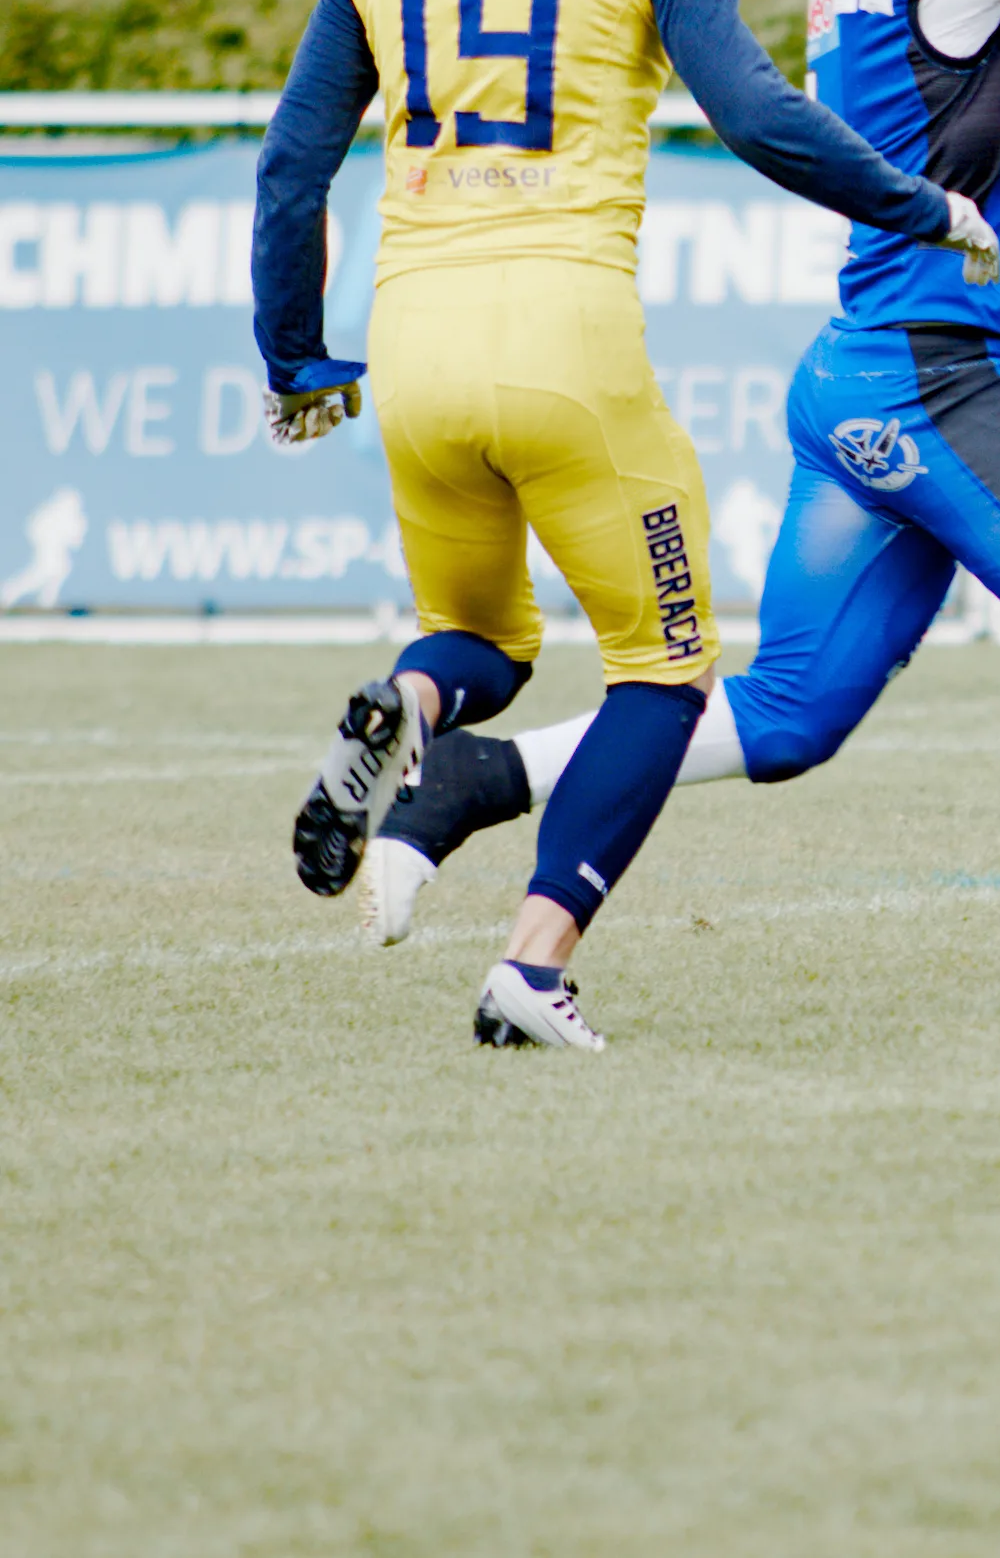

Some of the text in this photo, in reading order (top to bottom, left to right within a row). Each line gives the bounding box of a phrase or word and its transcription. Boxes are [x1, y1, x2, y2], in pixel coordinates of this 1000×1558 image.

[448, 165, 557, 189] veeser
[0, 199, 343, 309] CHMI
[35, 366, 179, 457] WE
[655, 364, 788, 454] ER
[642, 504, 703, 661] BIBERACH
